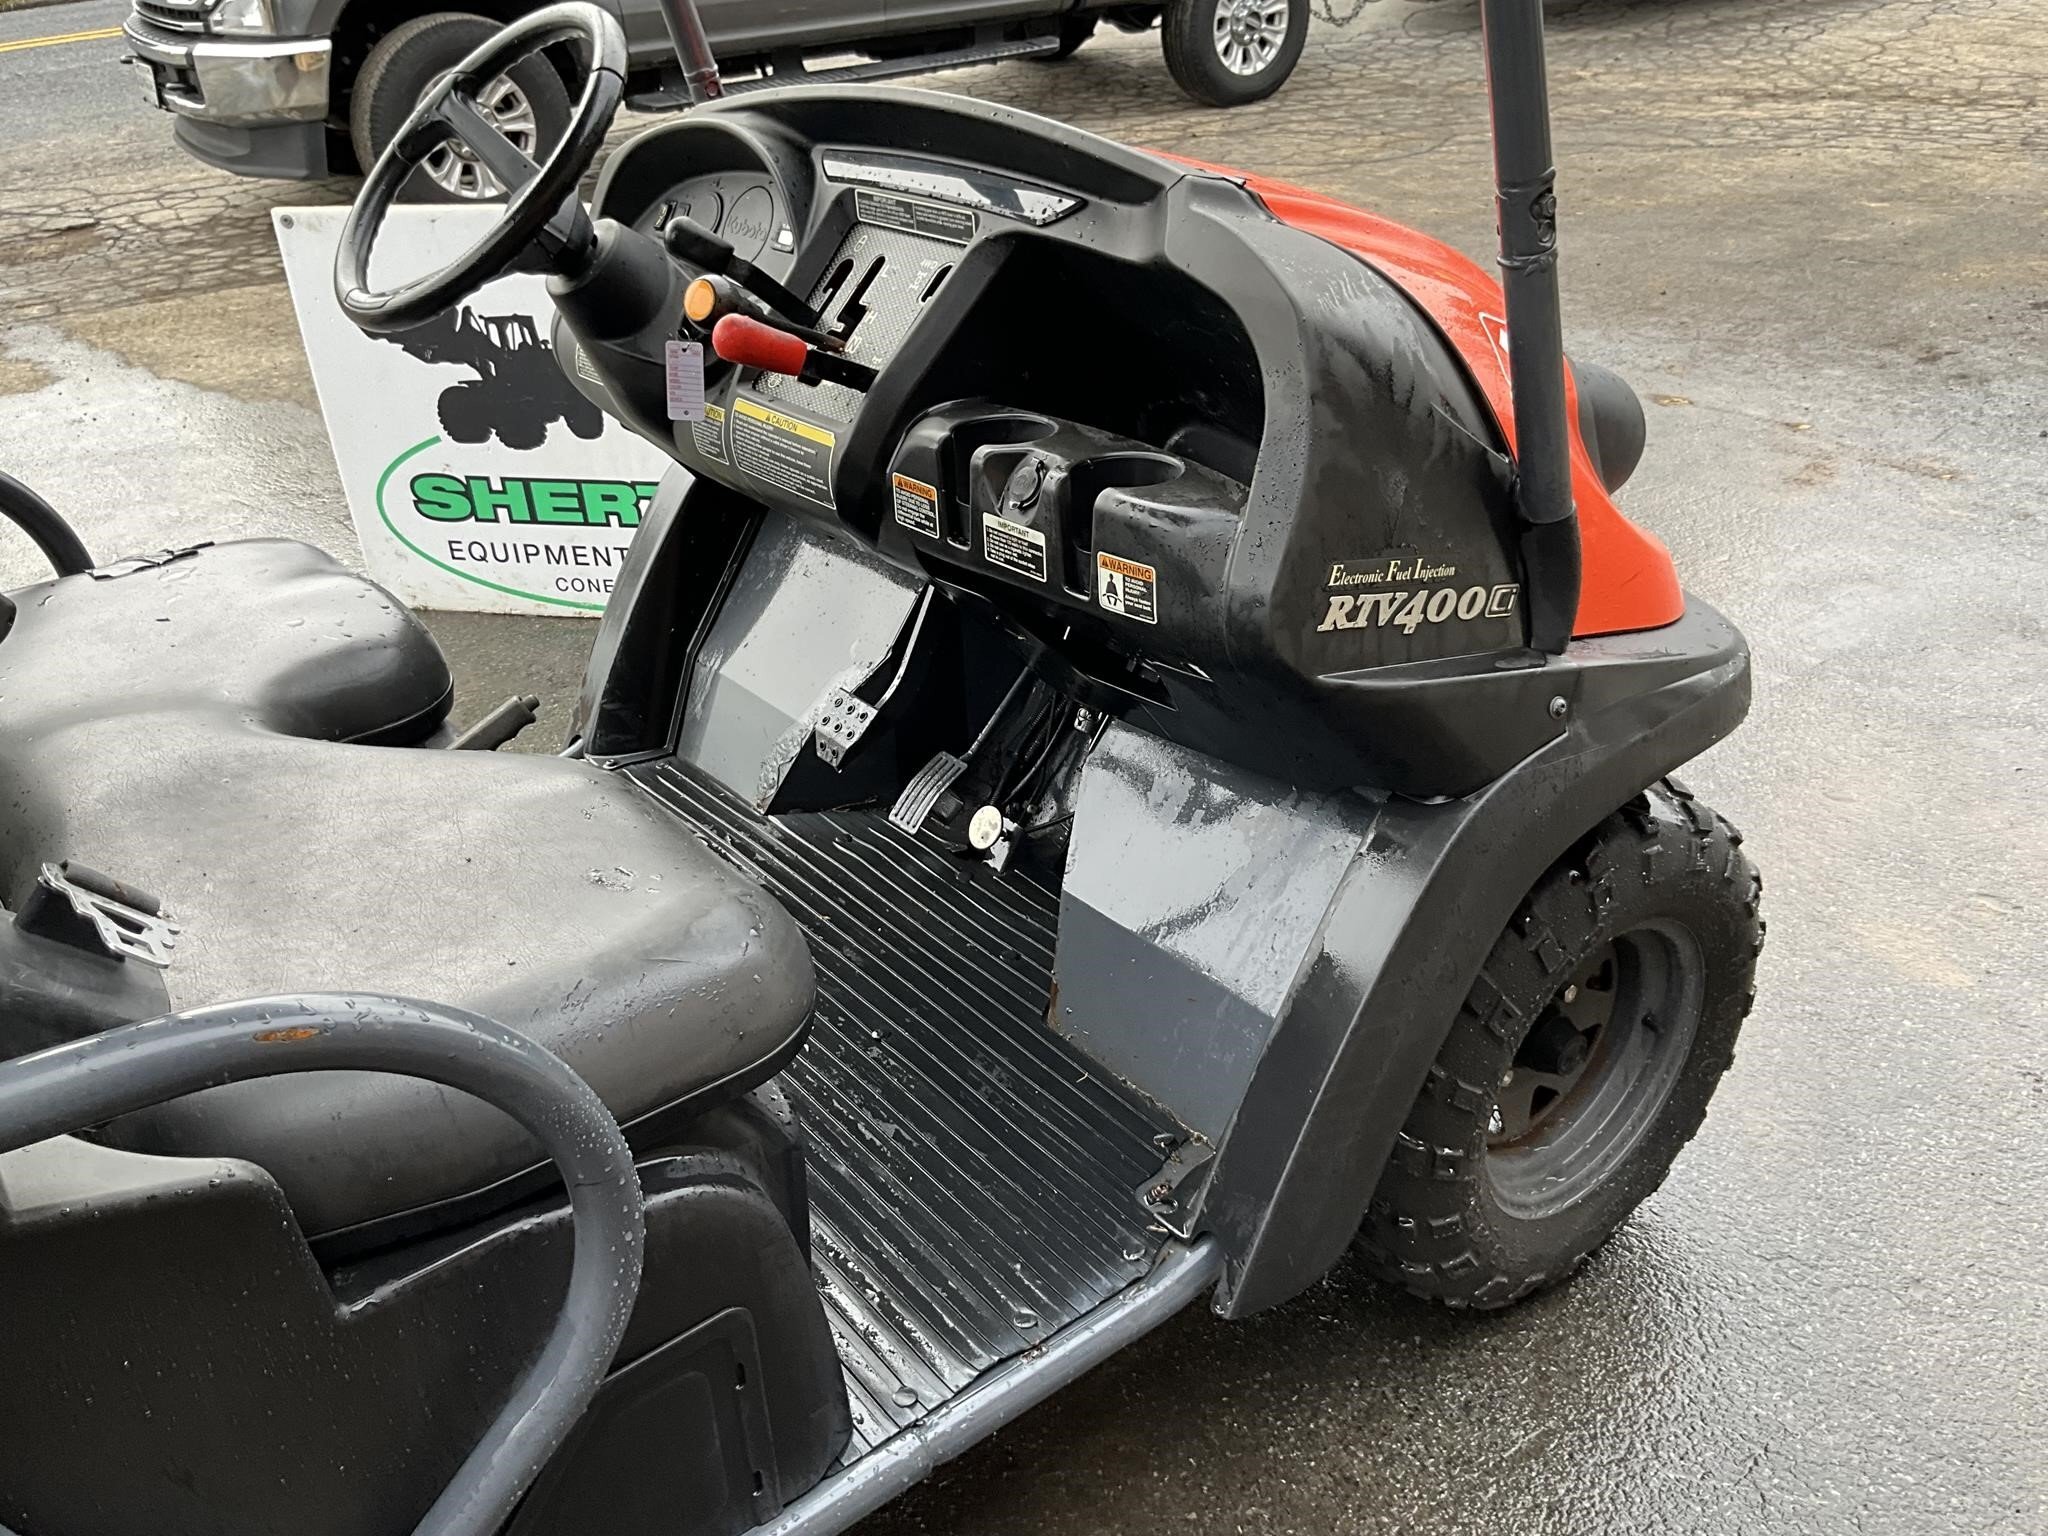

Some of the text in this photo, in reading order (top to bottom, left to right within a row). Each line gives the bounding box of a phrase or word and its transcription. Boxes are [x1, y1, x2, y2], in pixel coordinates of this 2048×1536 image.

[727, 214, 767, 242] Kubota
[771, 415, 798, 432] CAUTION
[903, 481, 932, 498] WARNING
[997, 520, 1030, 538] IMPORTANT
[447, 539, 631, 567] EQUIPMENT
[1108, 559, 1152, 580] WARNING
[1327, 557, 1456, 587] Electronic Fuel Injection
